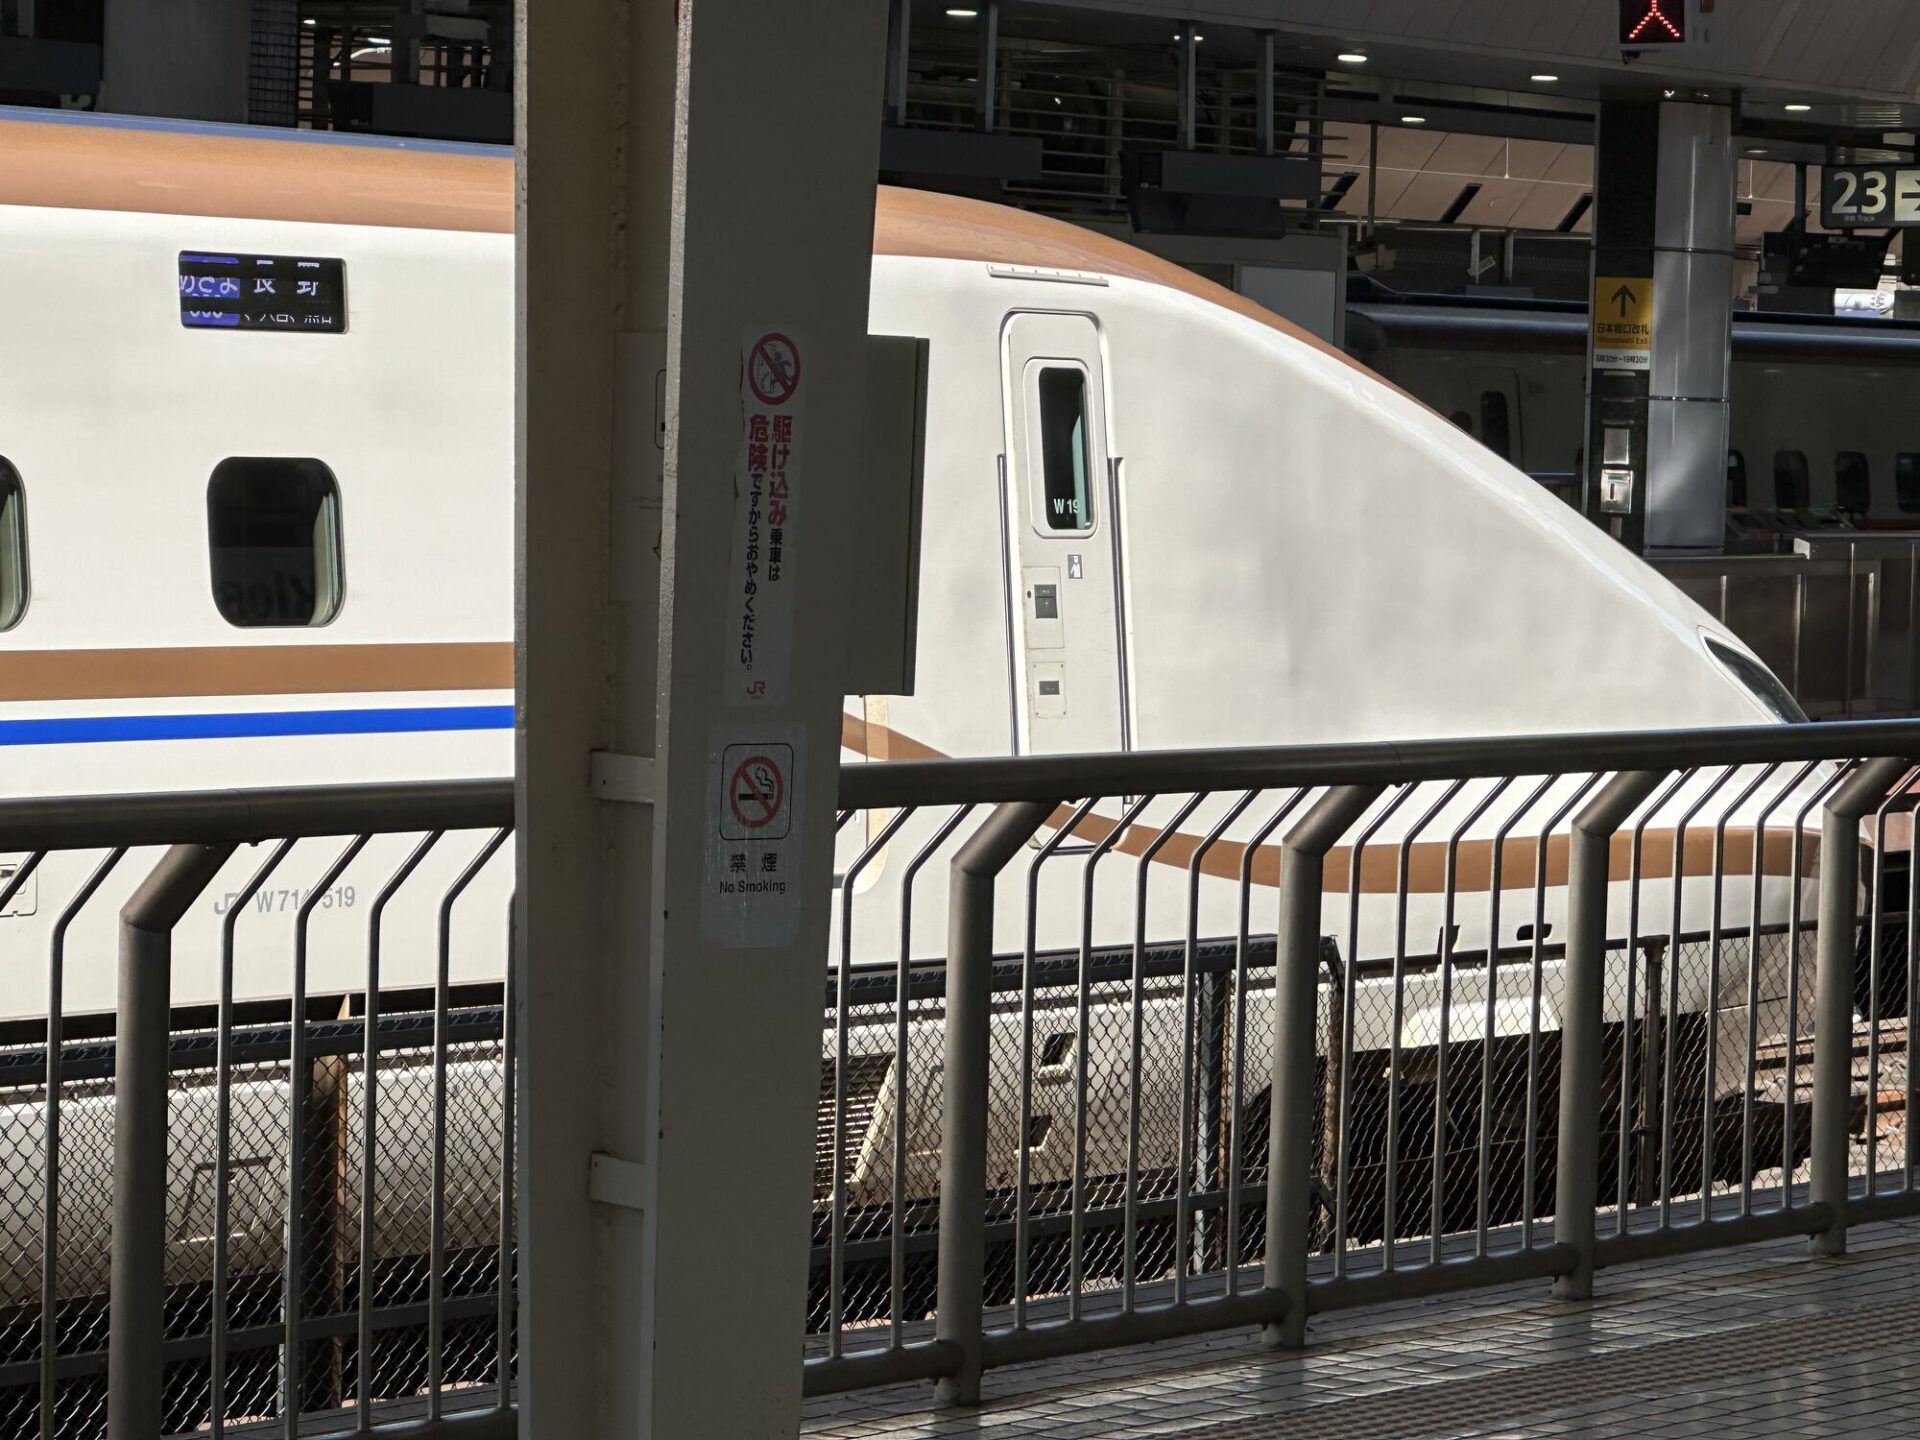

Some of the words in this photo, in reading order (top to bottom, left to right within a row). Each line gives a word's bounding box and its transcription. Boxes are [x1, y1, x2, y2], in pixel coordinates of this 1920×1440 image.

[1832, 171, 1887, 214] 23
[747, 680, 766, 695] JR
[720, 881, 735, 894] No
[738, 880, 786, 895] Smoking
